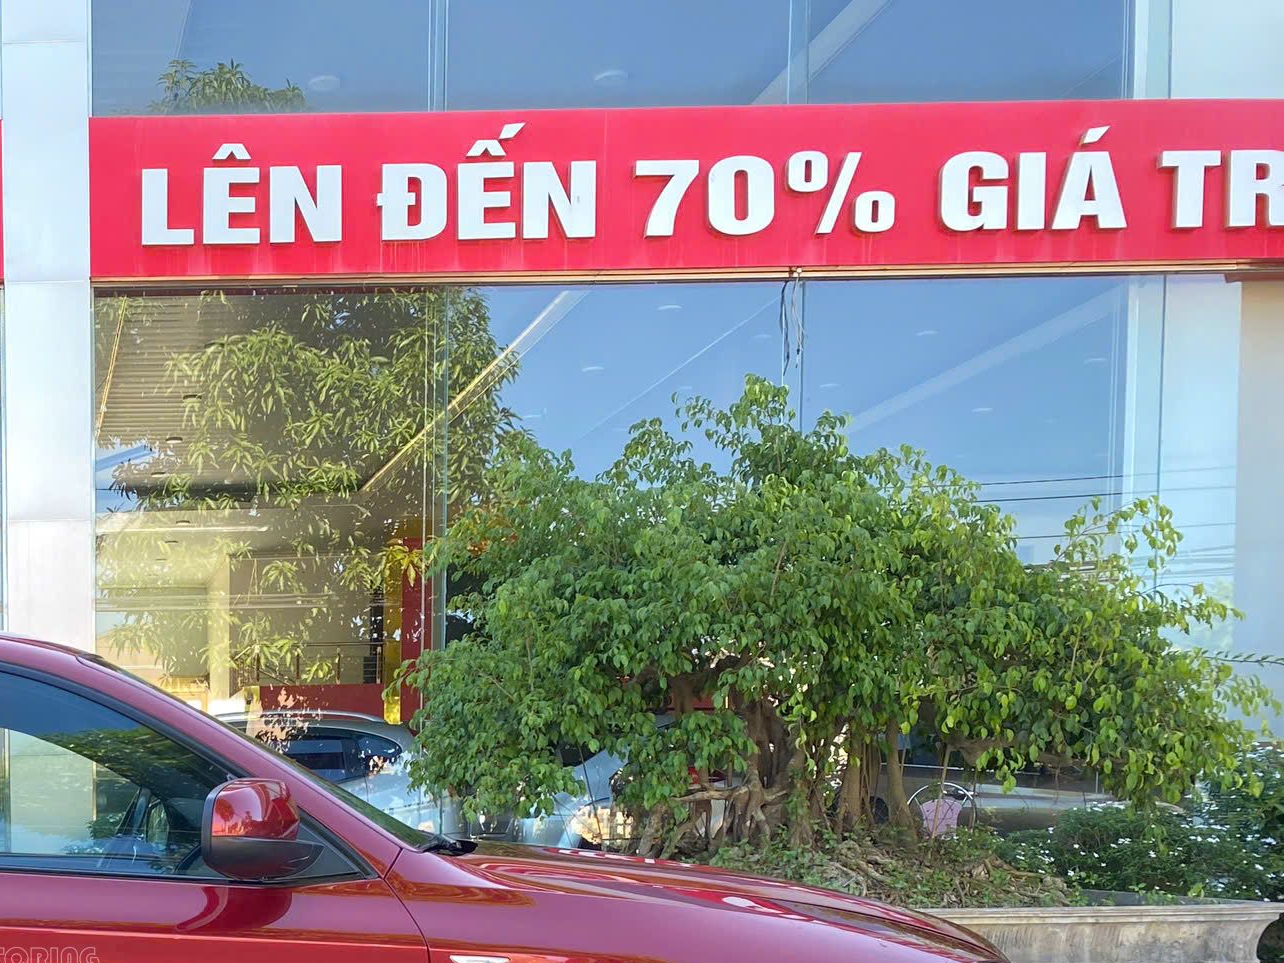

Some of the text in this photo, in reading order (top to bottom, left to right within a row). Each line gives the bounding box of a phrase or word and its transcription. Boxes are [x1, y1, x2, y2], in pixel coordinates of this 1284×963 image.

[141, 143, 343, 246] LÊN
[376, 122, 597, 241] ĐẾN
[635, 150, 896, 237] 70%
[940, 125, 1128, 232] GIÁ
